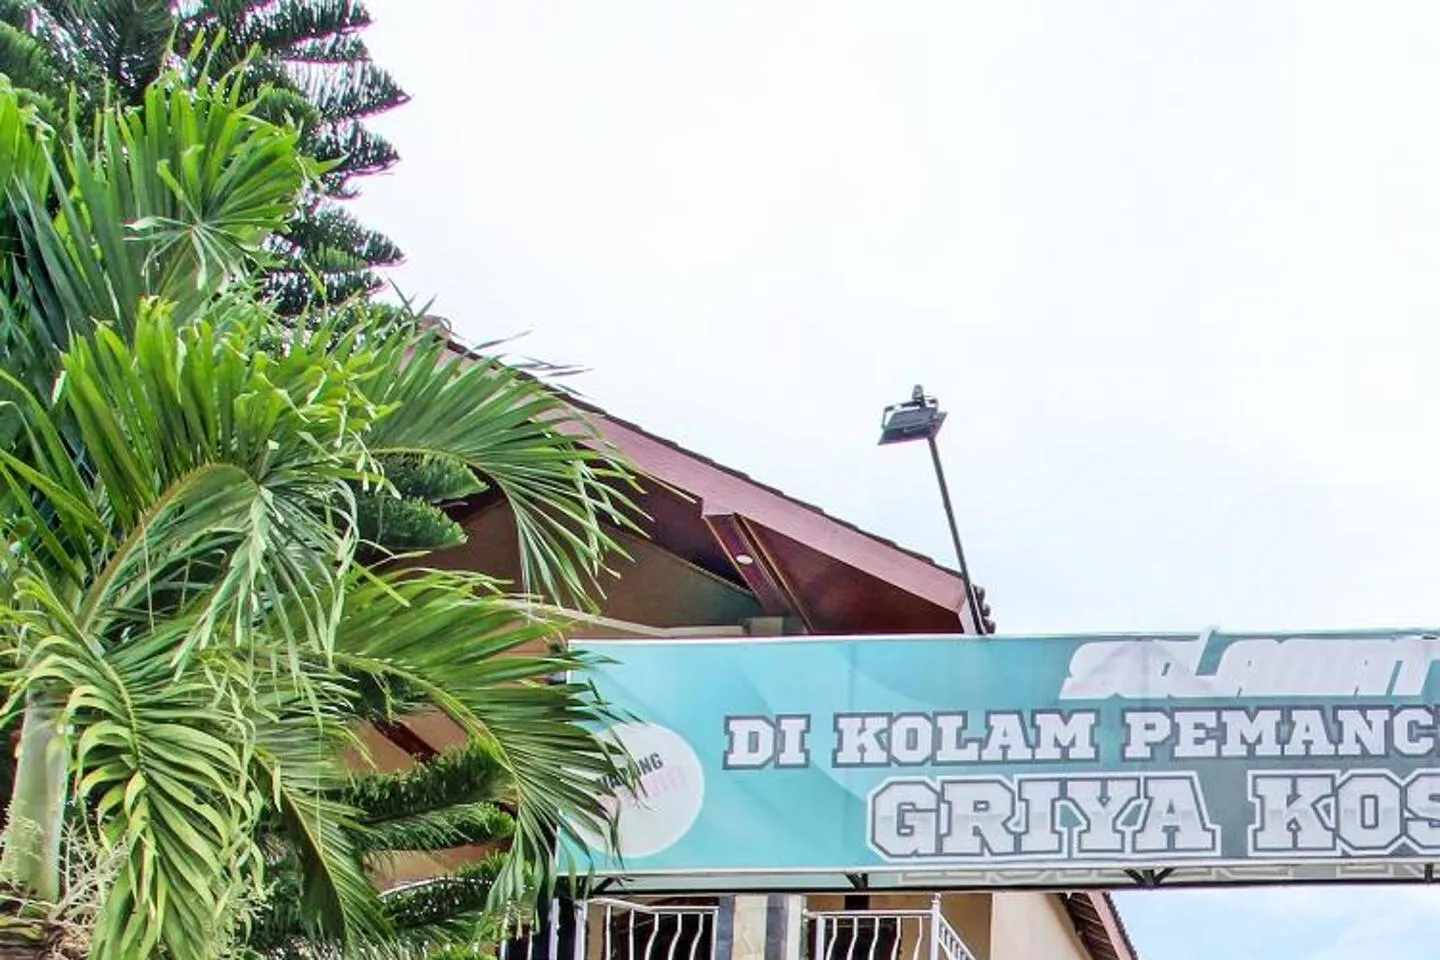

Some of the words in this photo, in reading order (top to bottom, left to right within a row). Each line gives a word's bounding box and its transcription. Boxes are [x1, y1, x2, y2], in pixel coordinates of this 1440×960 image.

[724, 713, 811, 770] DI
[832, 709, 1100, 769] KOLAM
[868, 771, 1223, 862] GRIYA
